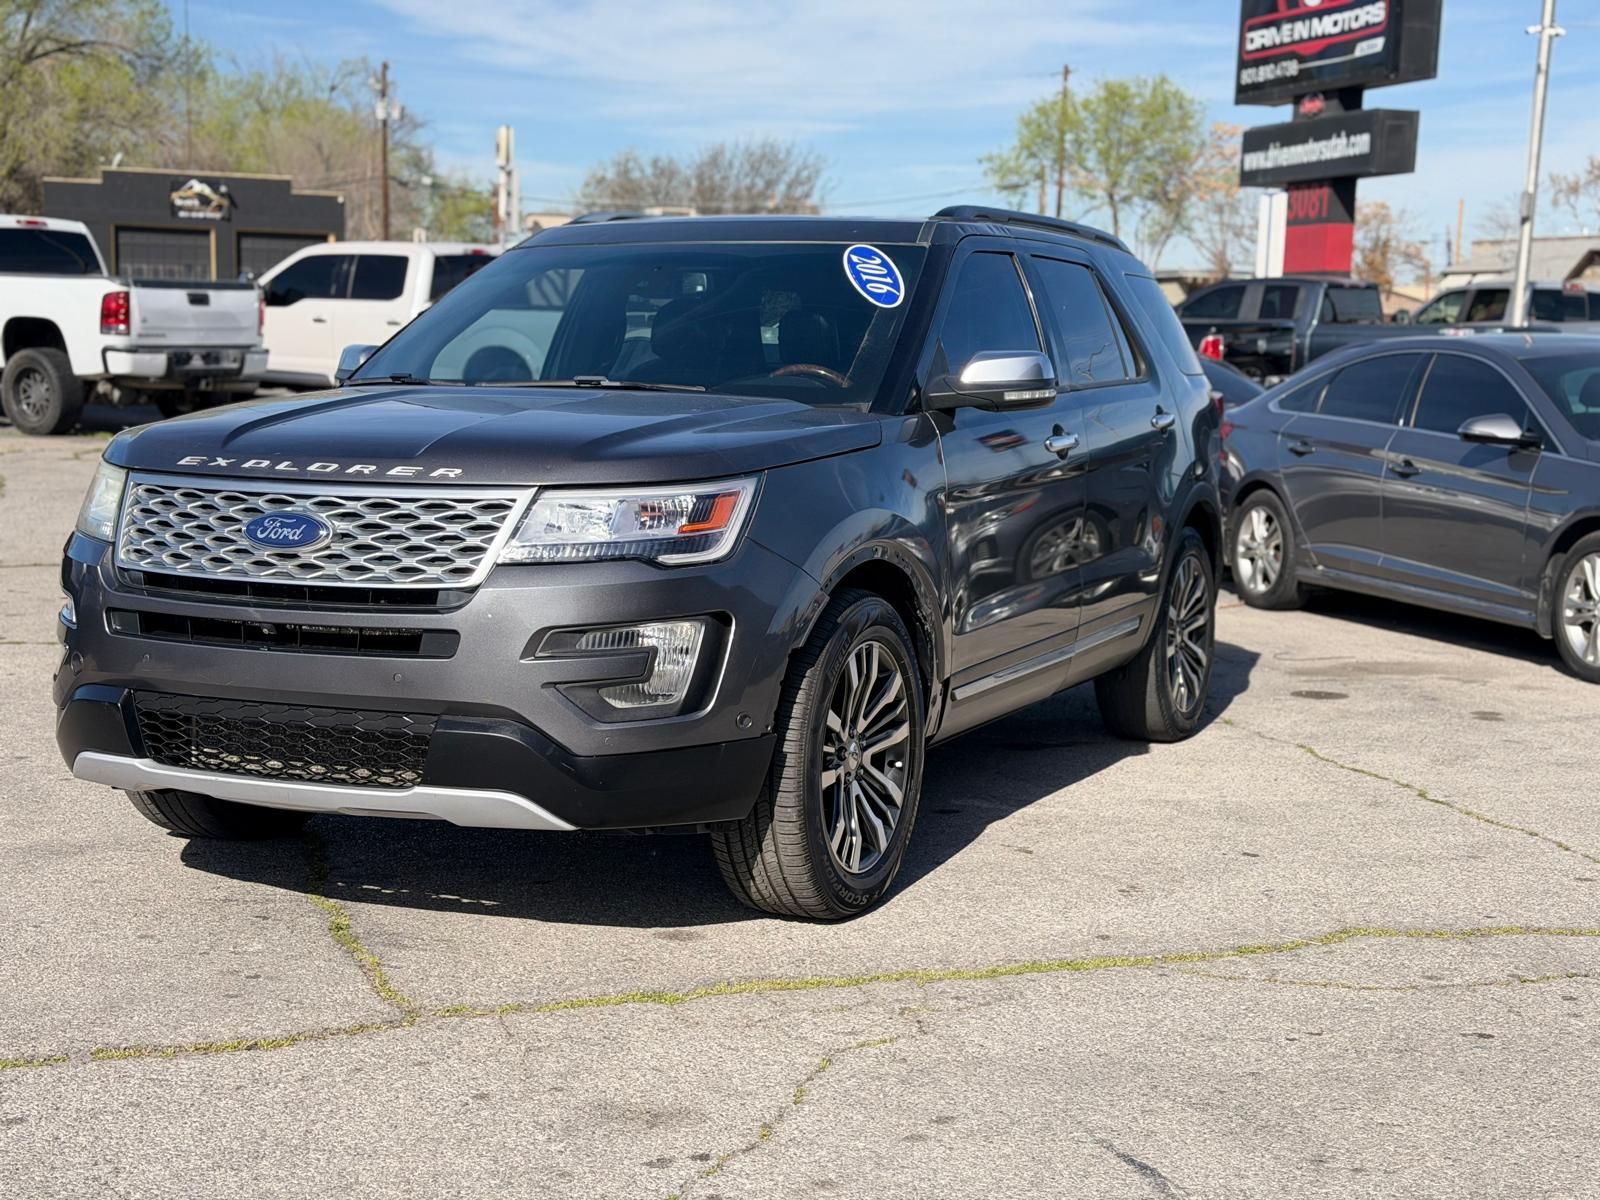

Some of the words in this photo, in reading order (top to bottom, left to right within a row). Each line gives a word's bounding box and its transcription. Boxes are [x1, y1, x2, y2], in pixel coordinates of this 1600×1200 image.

[1245, 19, 1311, 51] DRIVEN
[1311, 1, 1387, 38] MOTORS
[849, 253, 900, 296] 2016
[176, 455, 465, 479] EXPLORER
[256, 516, 304, 541] Ford
